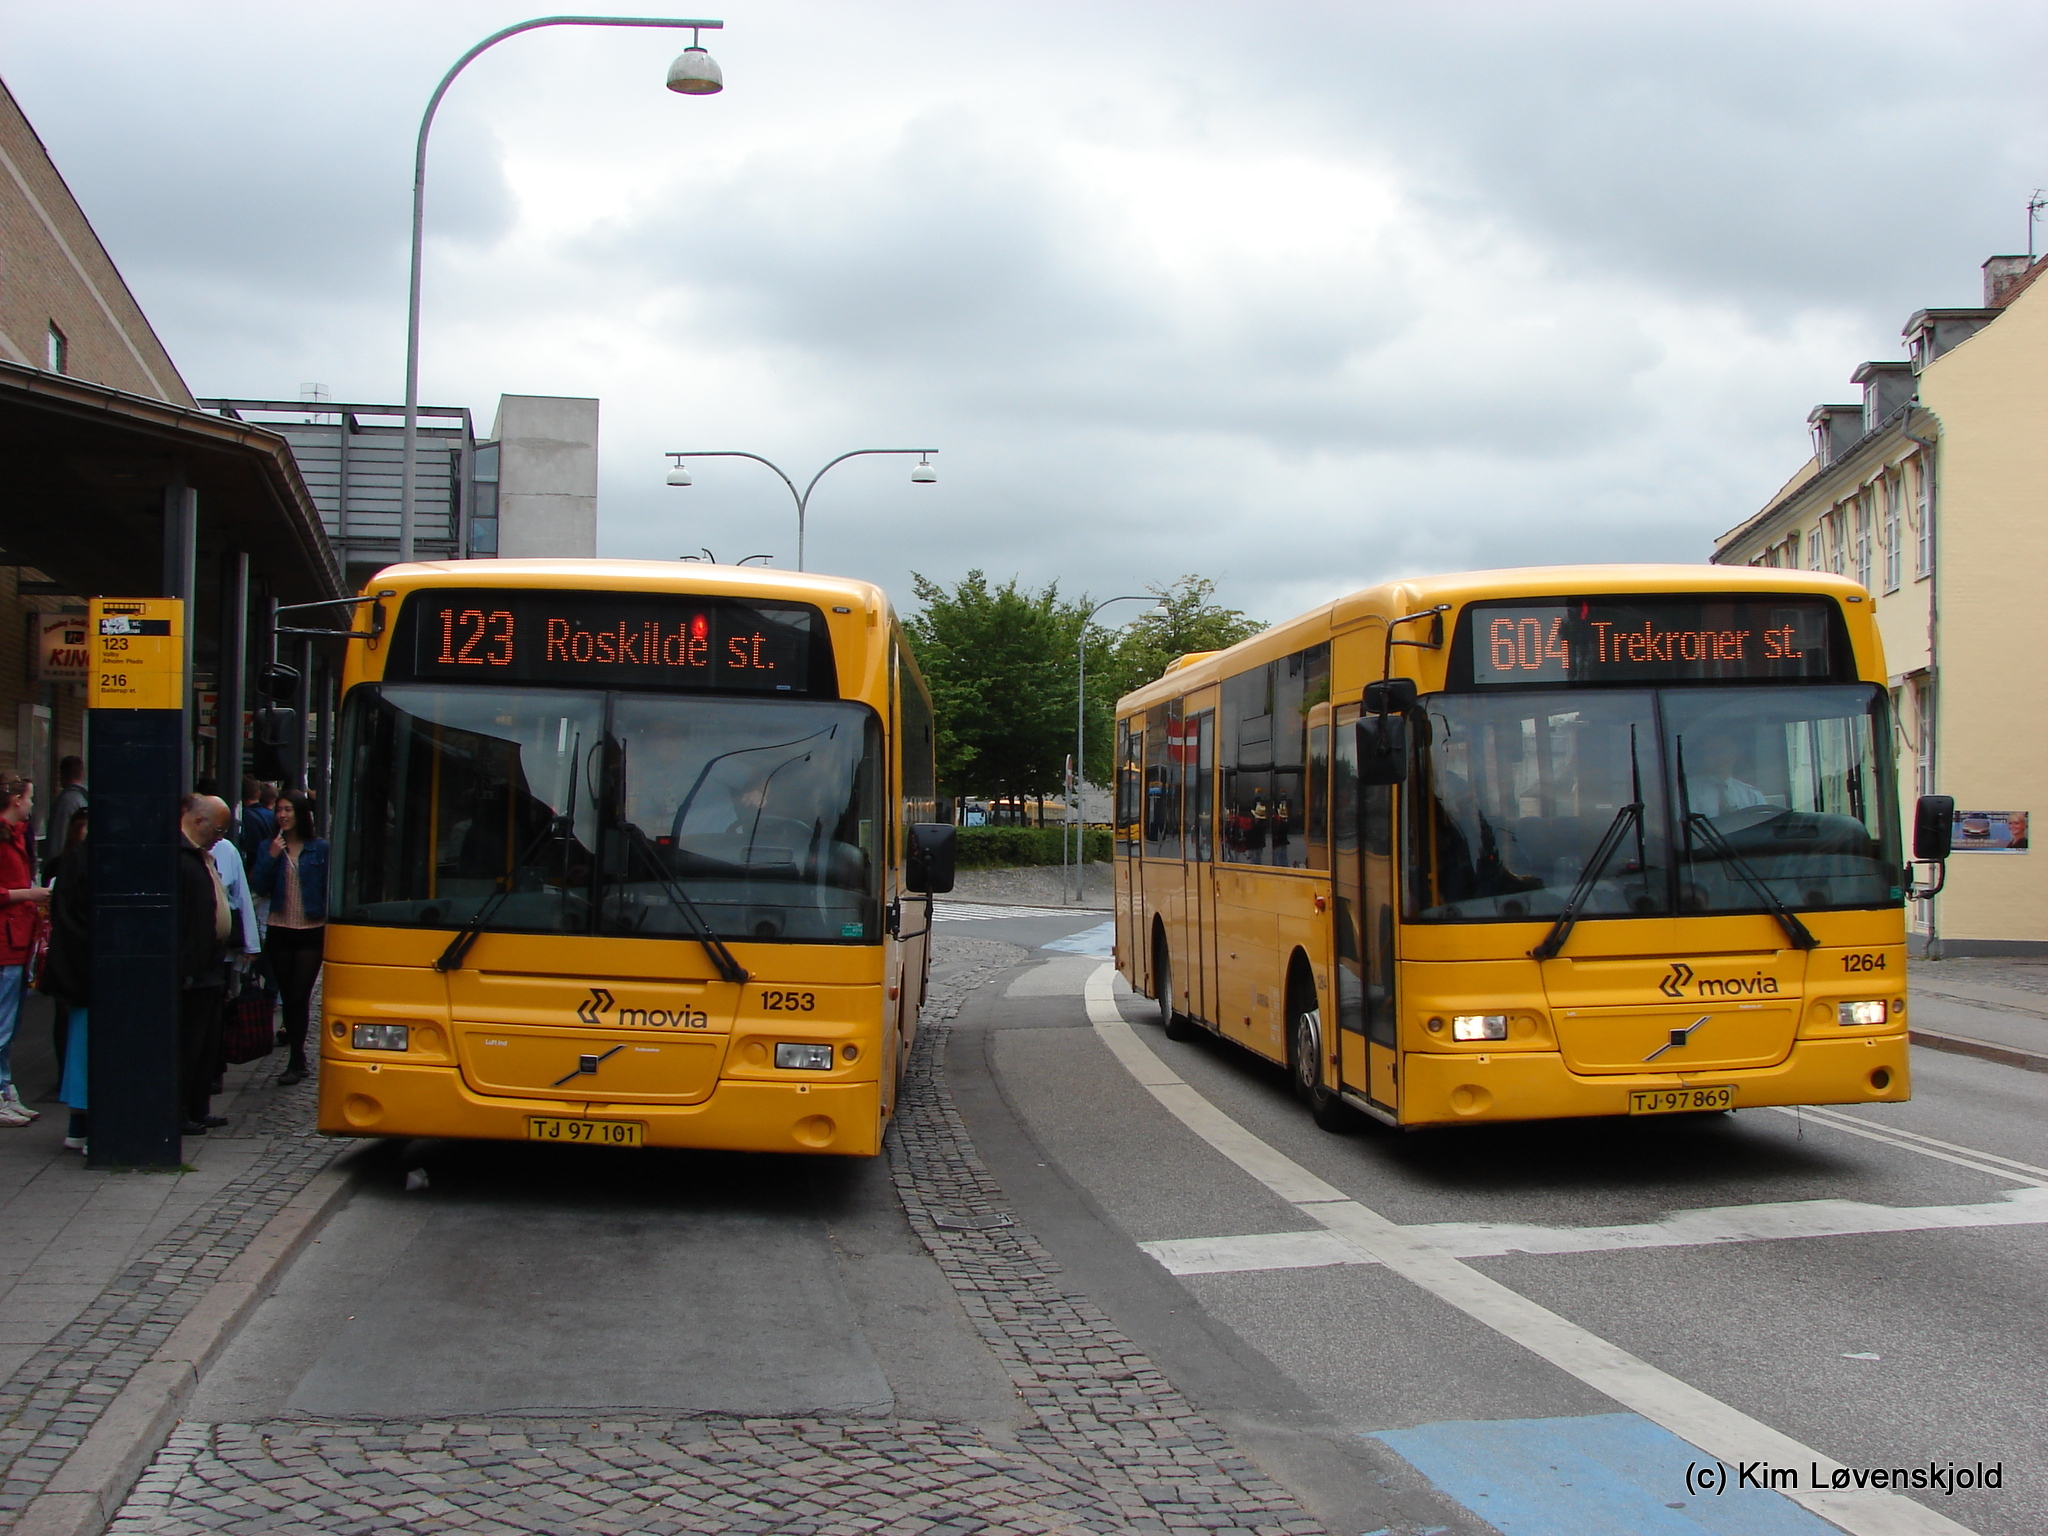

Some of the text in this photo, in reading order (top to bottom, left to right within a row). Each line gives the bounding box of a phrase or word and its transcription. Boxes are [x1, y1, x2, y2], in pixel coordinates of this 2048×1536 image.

[102, 637, 129, 651] 123
[437, 608, 775, 669] 123 Roskilde st.
[1489, 616, 1803, 671] 604 Trekroner st.
[101, 674, 127, 687] 216
[101, 687, 128, 695] Ballerup
[1840, 953, 1886, 973] 1264
[1698, 970, 1778, 997] movia
[760, 990, 816, 1012] 1253
[618, 1003, 708, 1029] movia
[1633, 1089, 1730, 1111] TJ 97 869
[533, 1120, 633, 1142] TJ 97 101
